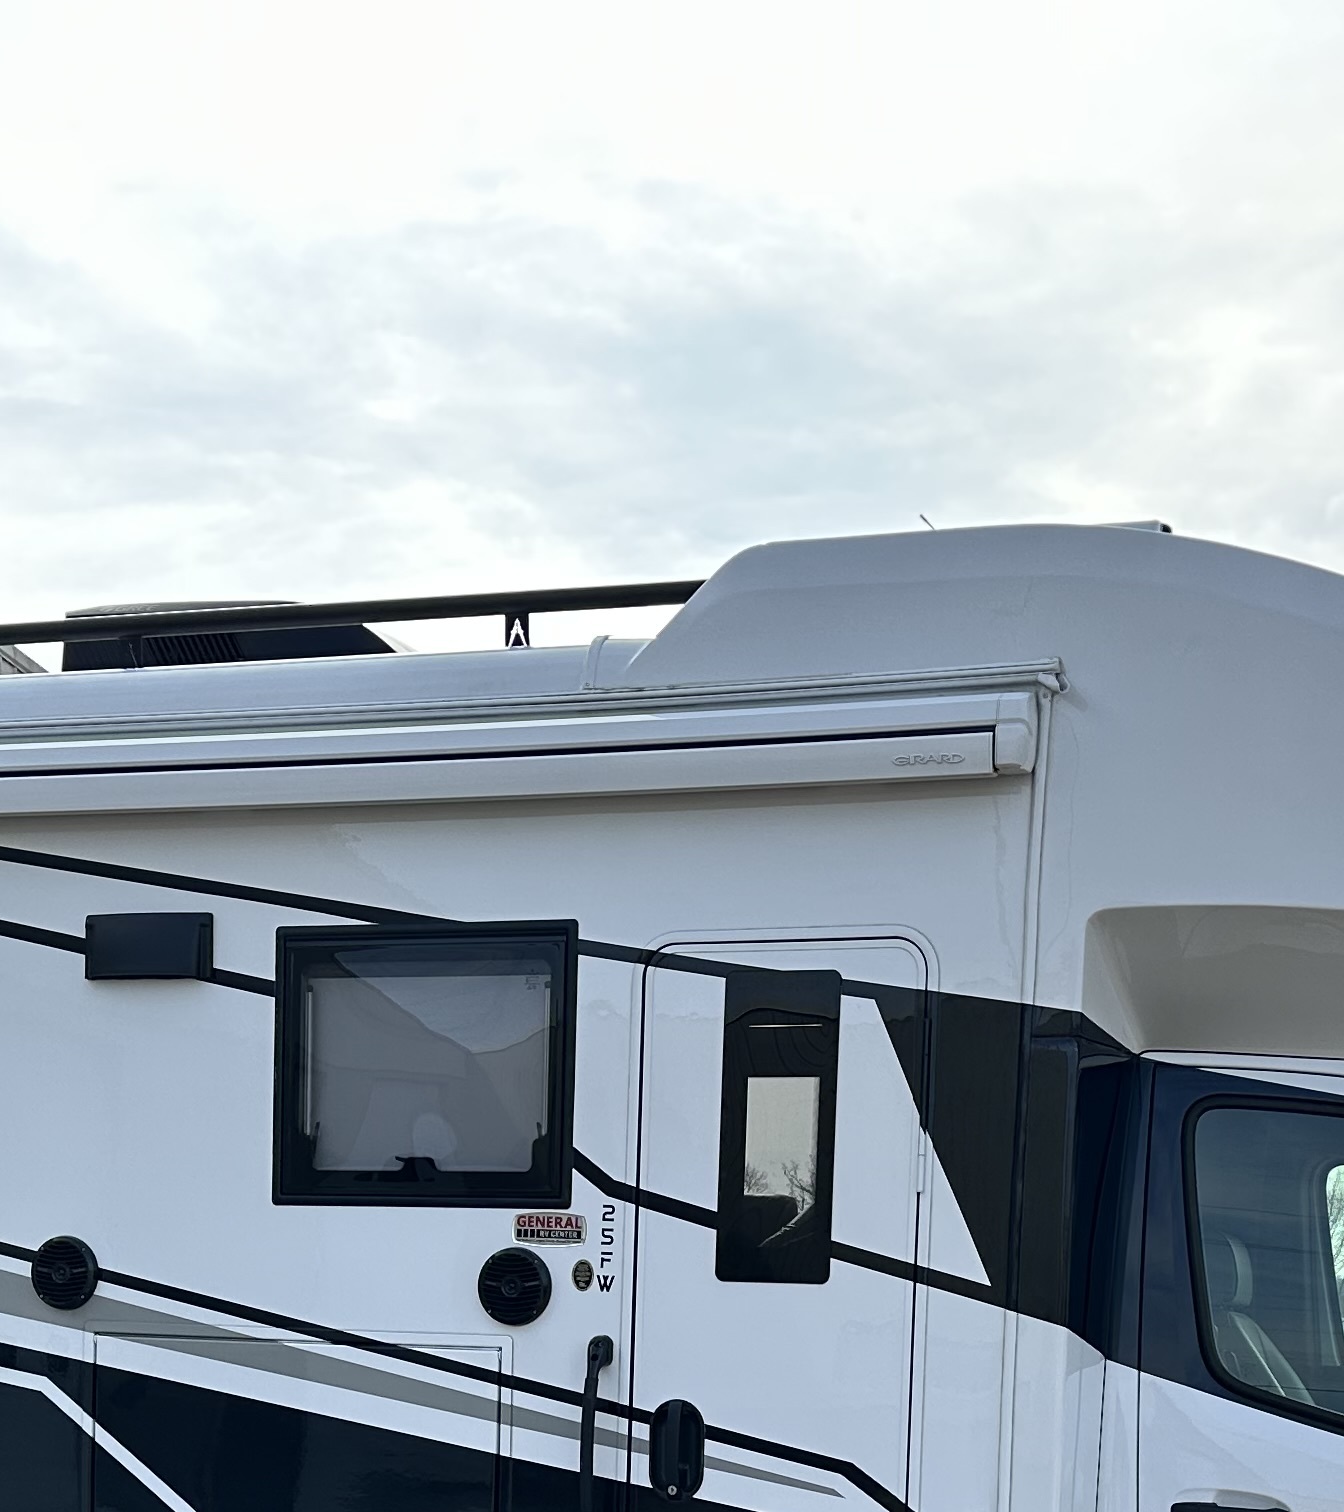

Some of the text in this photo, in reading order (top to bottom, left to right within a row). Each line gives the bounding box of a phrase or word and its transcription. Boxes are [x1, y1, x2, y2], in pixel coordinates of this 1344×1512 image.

[891, 752, 966, 767] GIRARD
[516, 1215, 583, 1229] GENERAL
[539, 1230, 550, 1238] RV
[596, 1204, 616, 1293] 25FW
